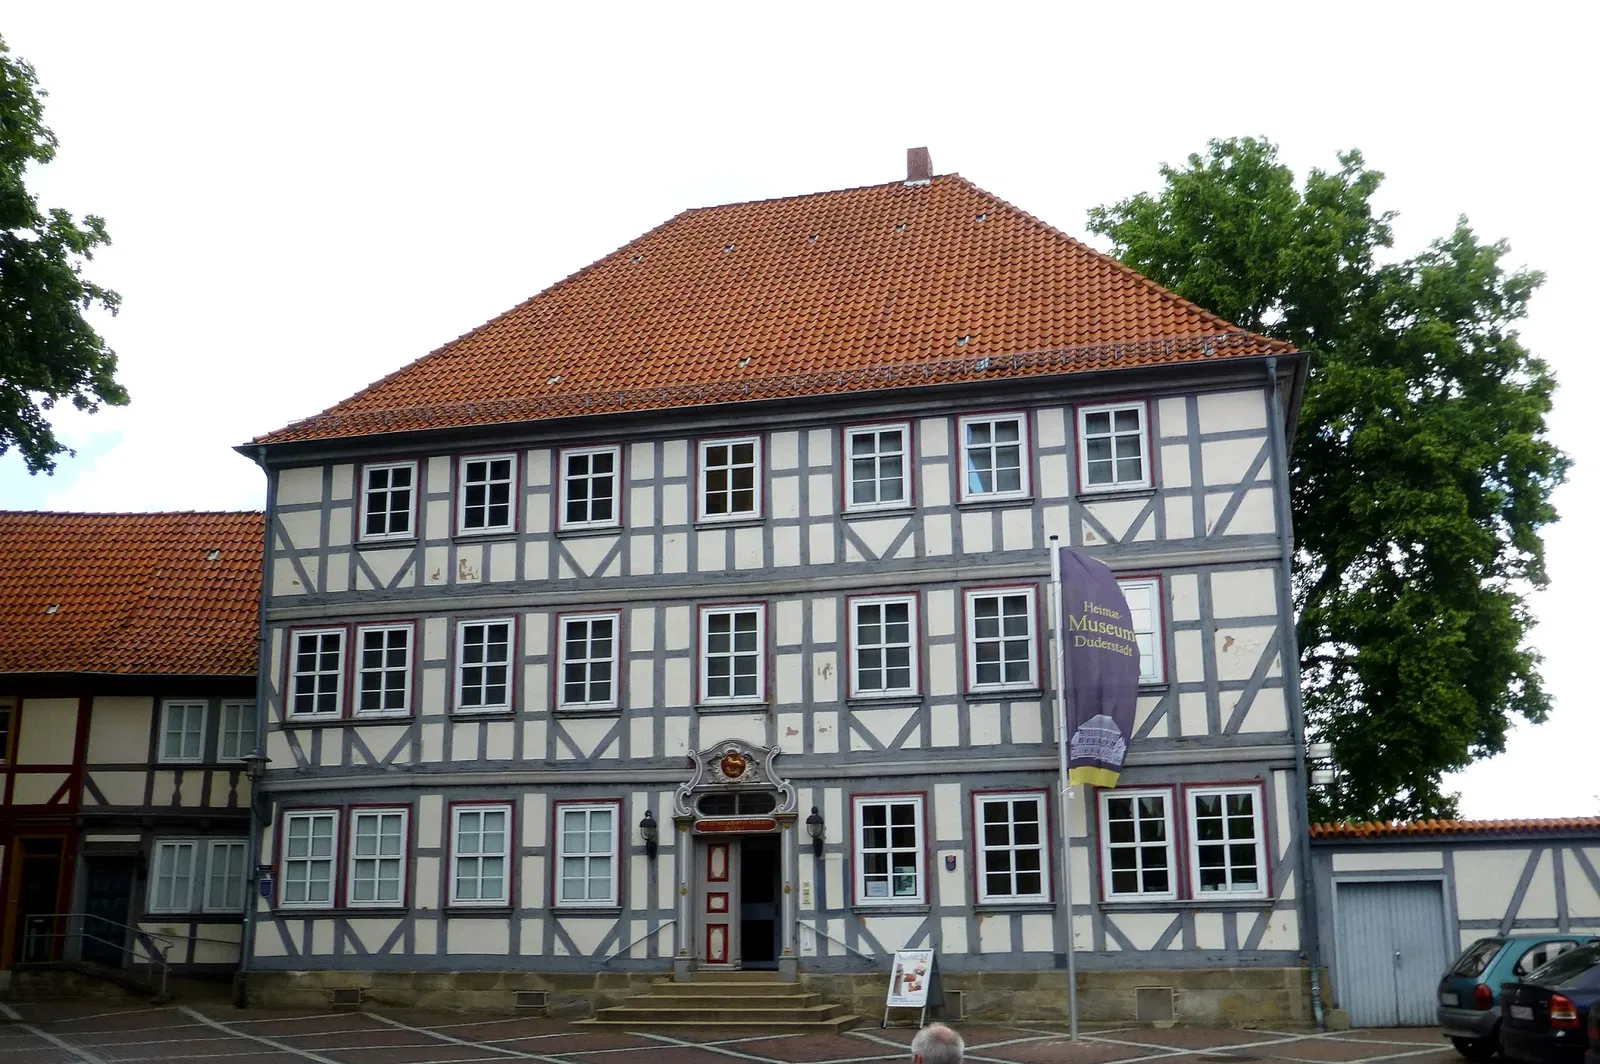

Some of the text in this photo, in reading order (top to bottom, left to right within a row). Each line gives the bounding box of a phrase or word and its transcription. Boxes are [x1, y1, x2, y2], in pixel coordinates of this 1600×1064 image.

[1083, 600, 1122, 620] Heimat-
[1068, 614, 1136, 642] Museum
[1074, 635, 1133, 656] Duderstadt
